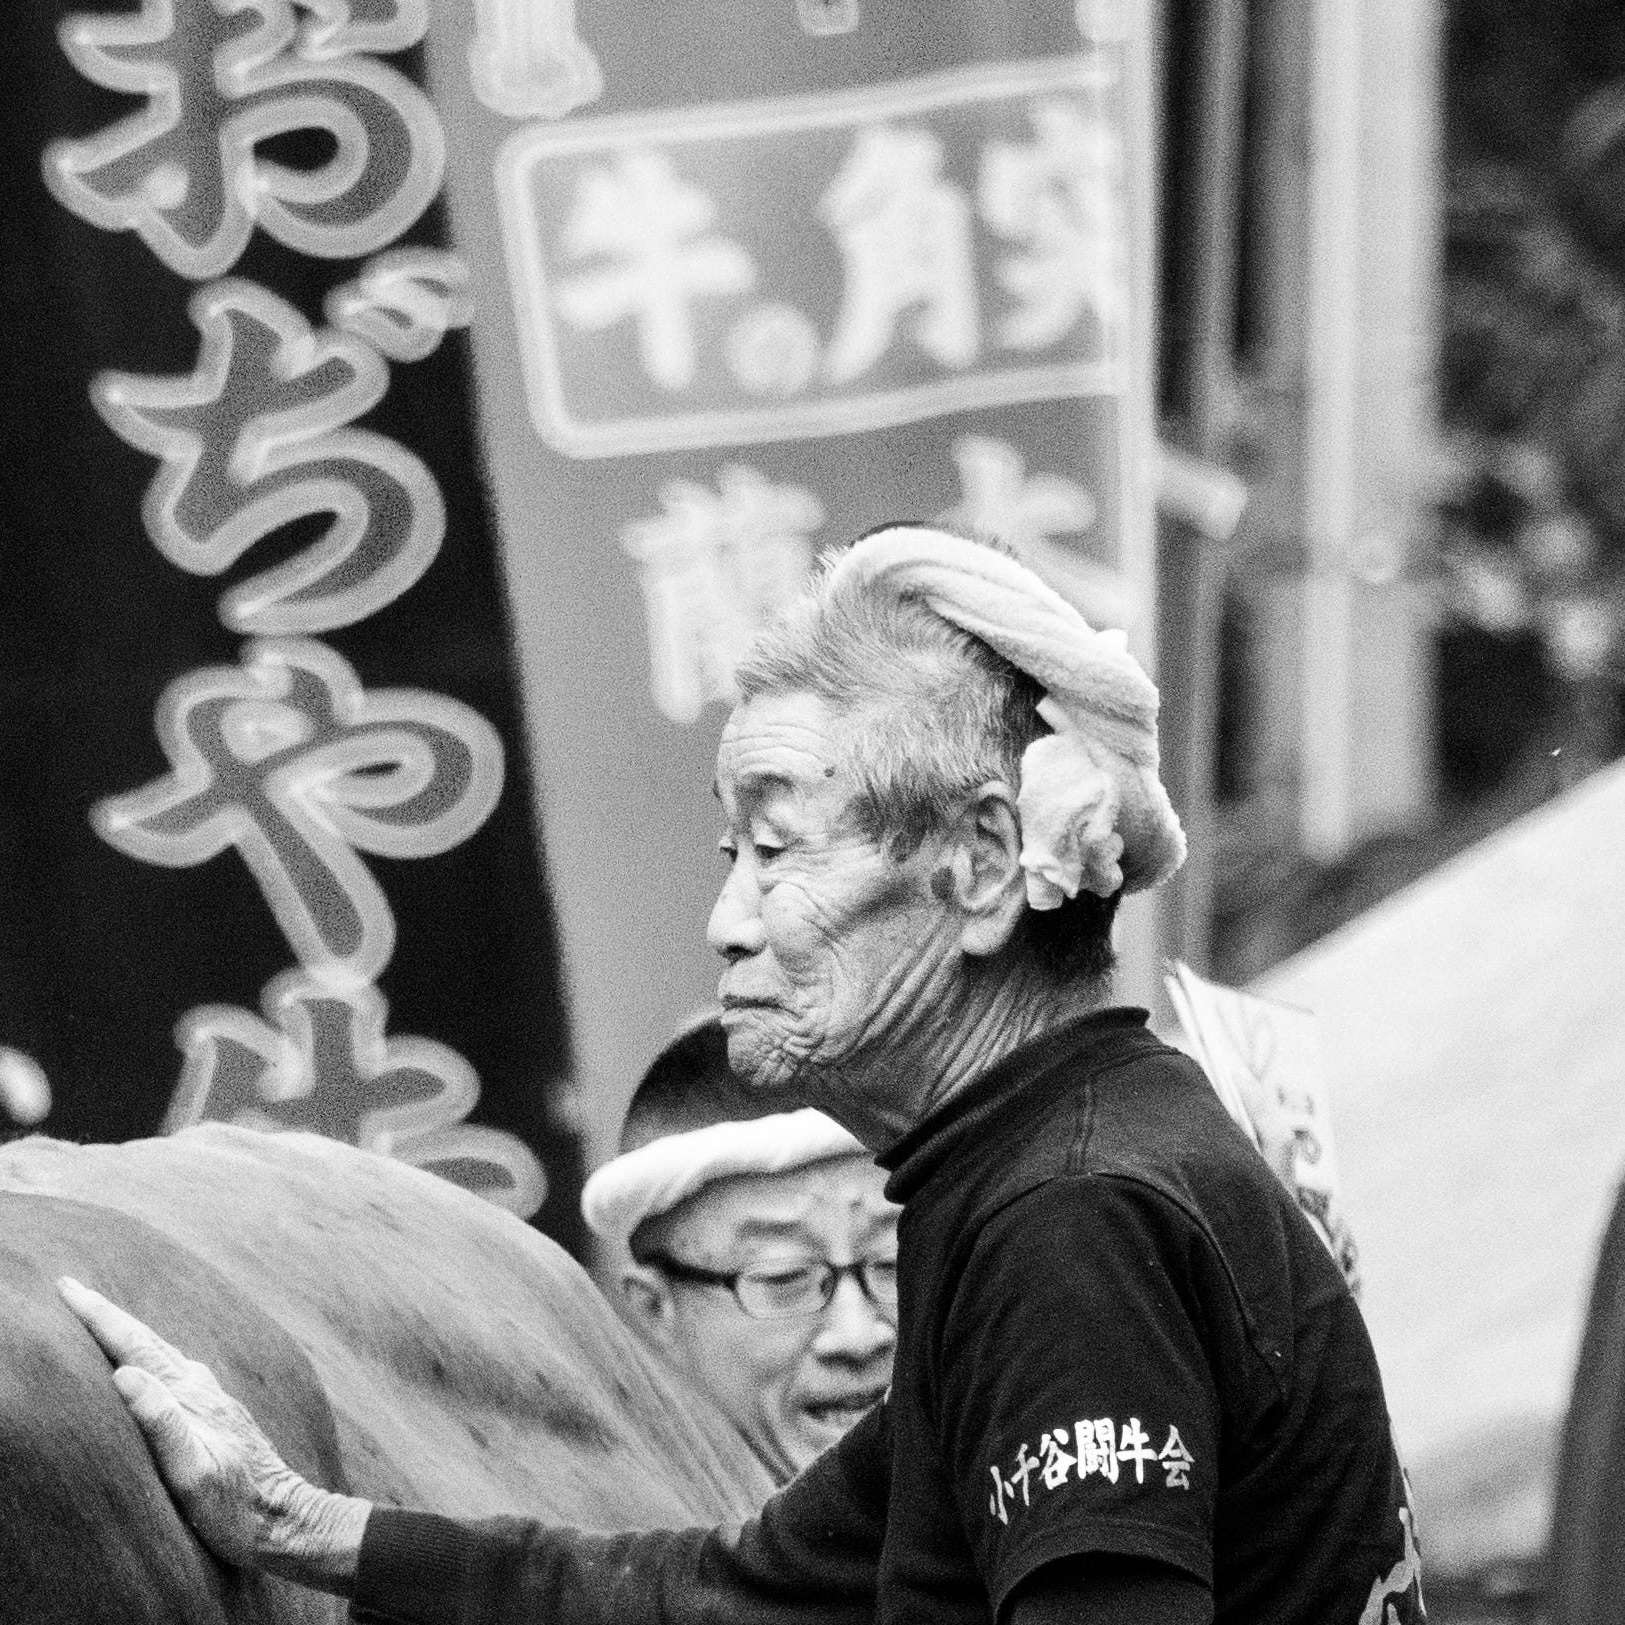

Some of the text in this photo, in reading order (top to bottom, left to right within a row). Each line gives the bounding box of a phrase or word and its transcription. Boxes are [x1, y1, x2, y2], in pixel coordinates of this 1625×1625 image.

[989, 1417, 1196, 1525] 小千谷闘牛会
